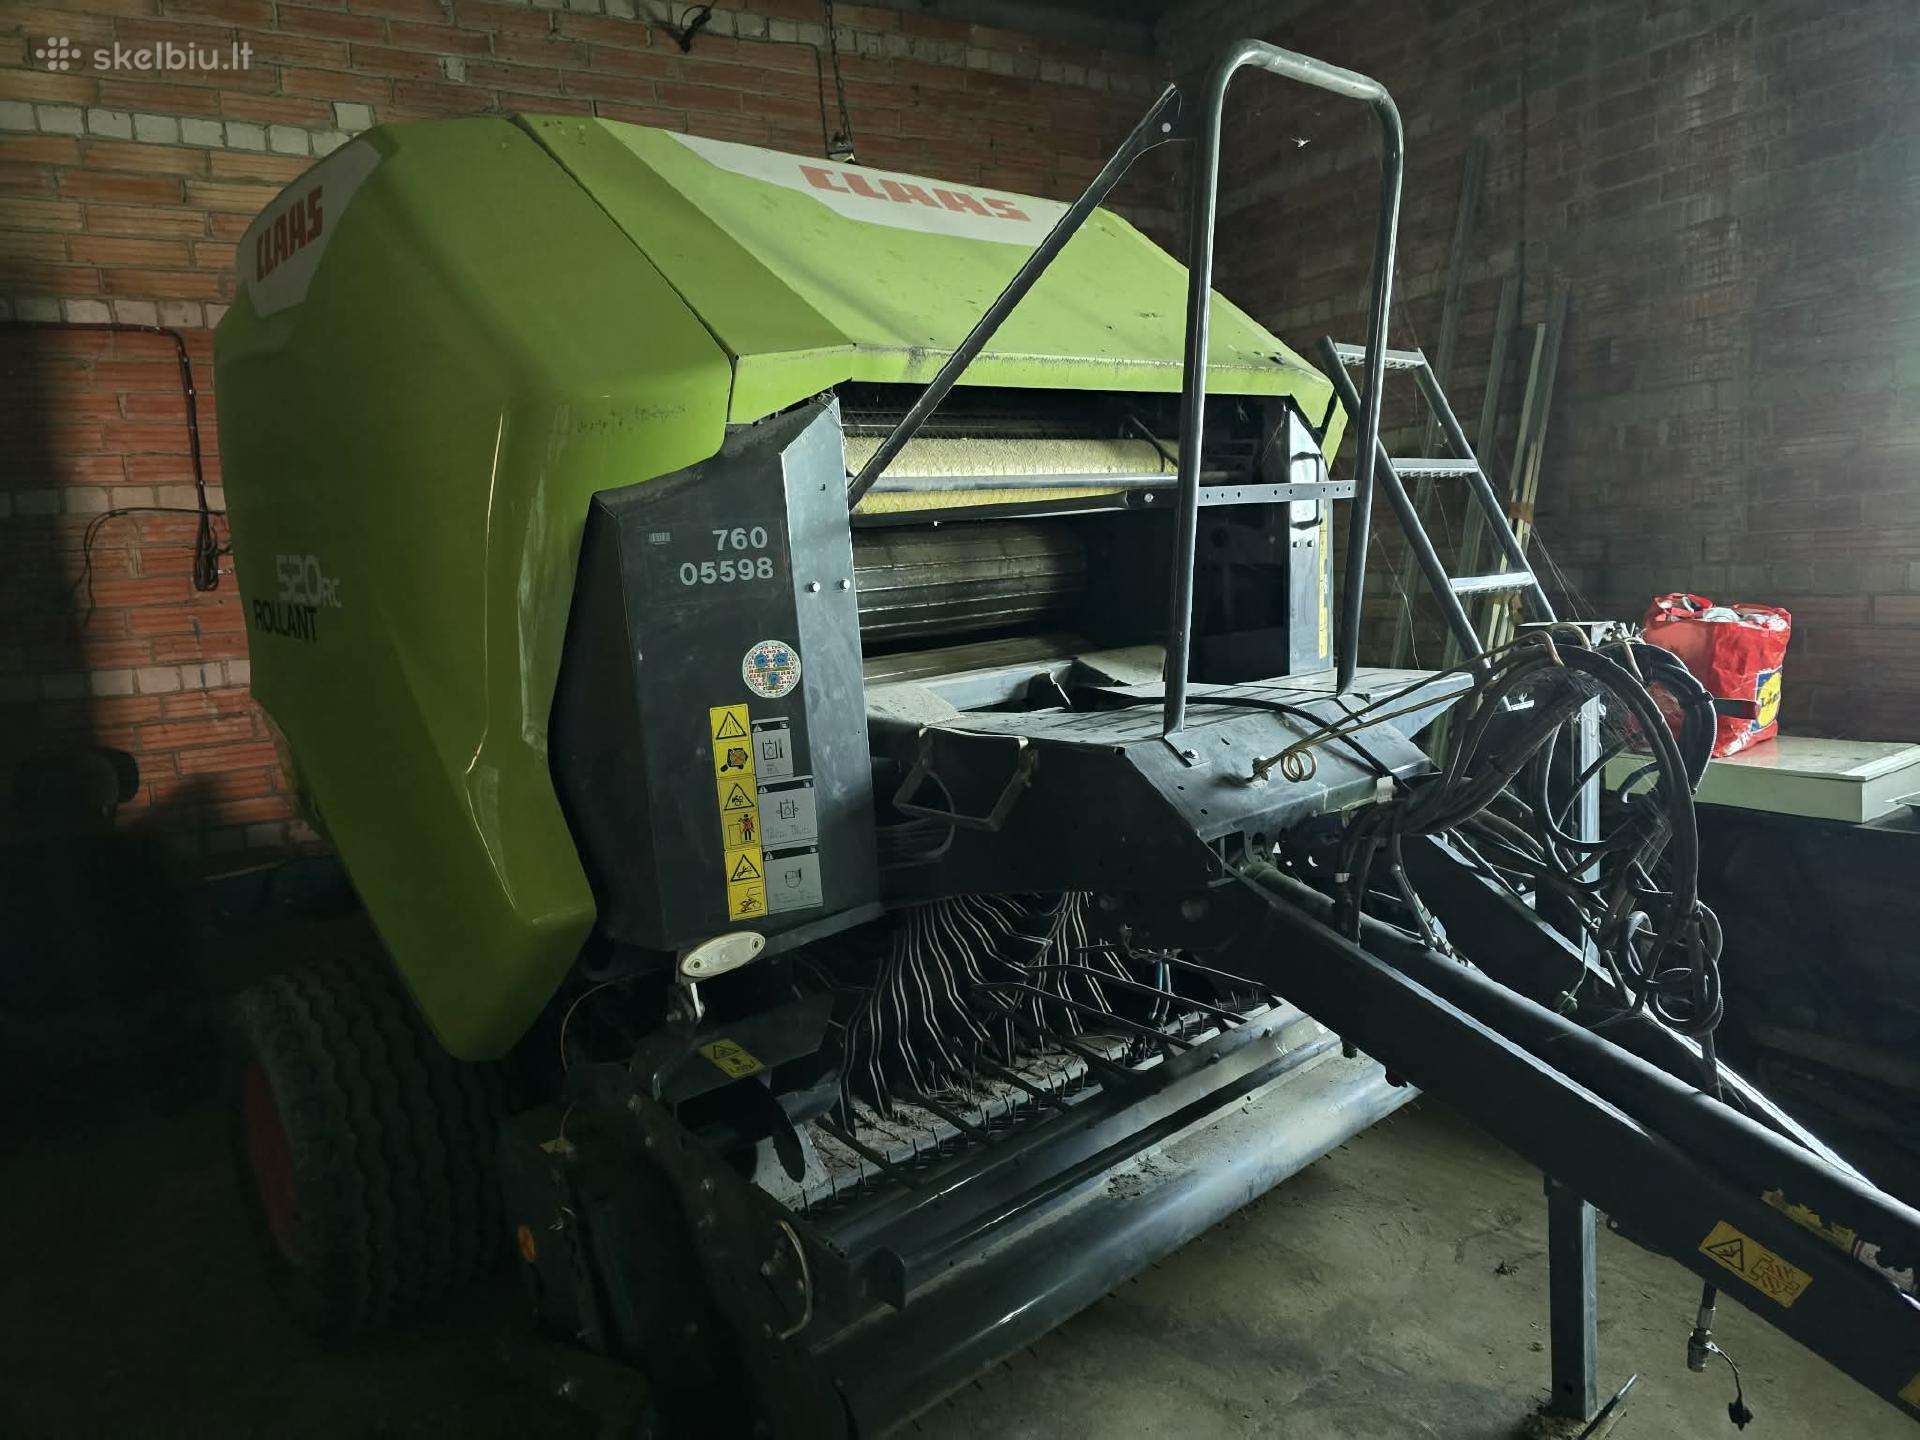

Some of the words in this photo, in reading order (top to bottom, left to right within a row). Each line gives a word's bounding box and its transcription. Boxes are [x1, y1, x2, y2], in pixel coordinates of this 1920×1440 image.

[799, 164, 1031, 222] CLAAS
[256, 184, 324, 283] CLAAS
[712, 526, 768, 550] 760
[679, 557, 774, 586] 05598
